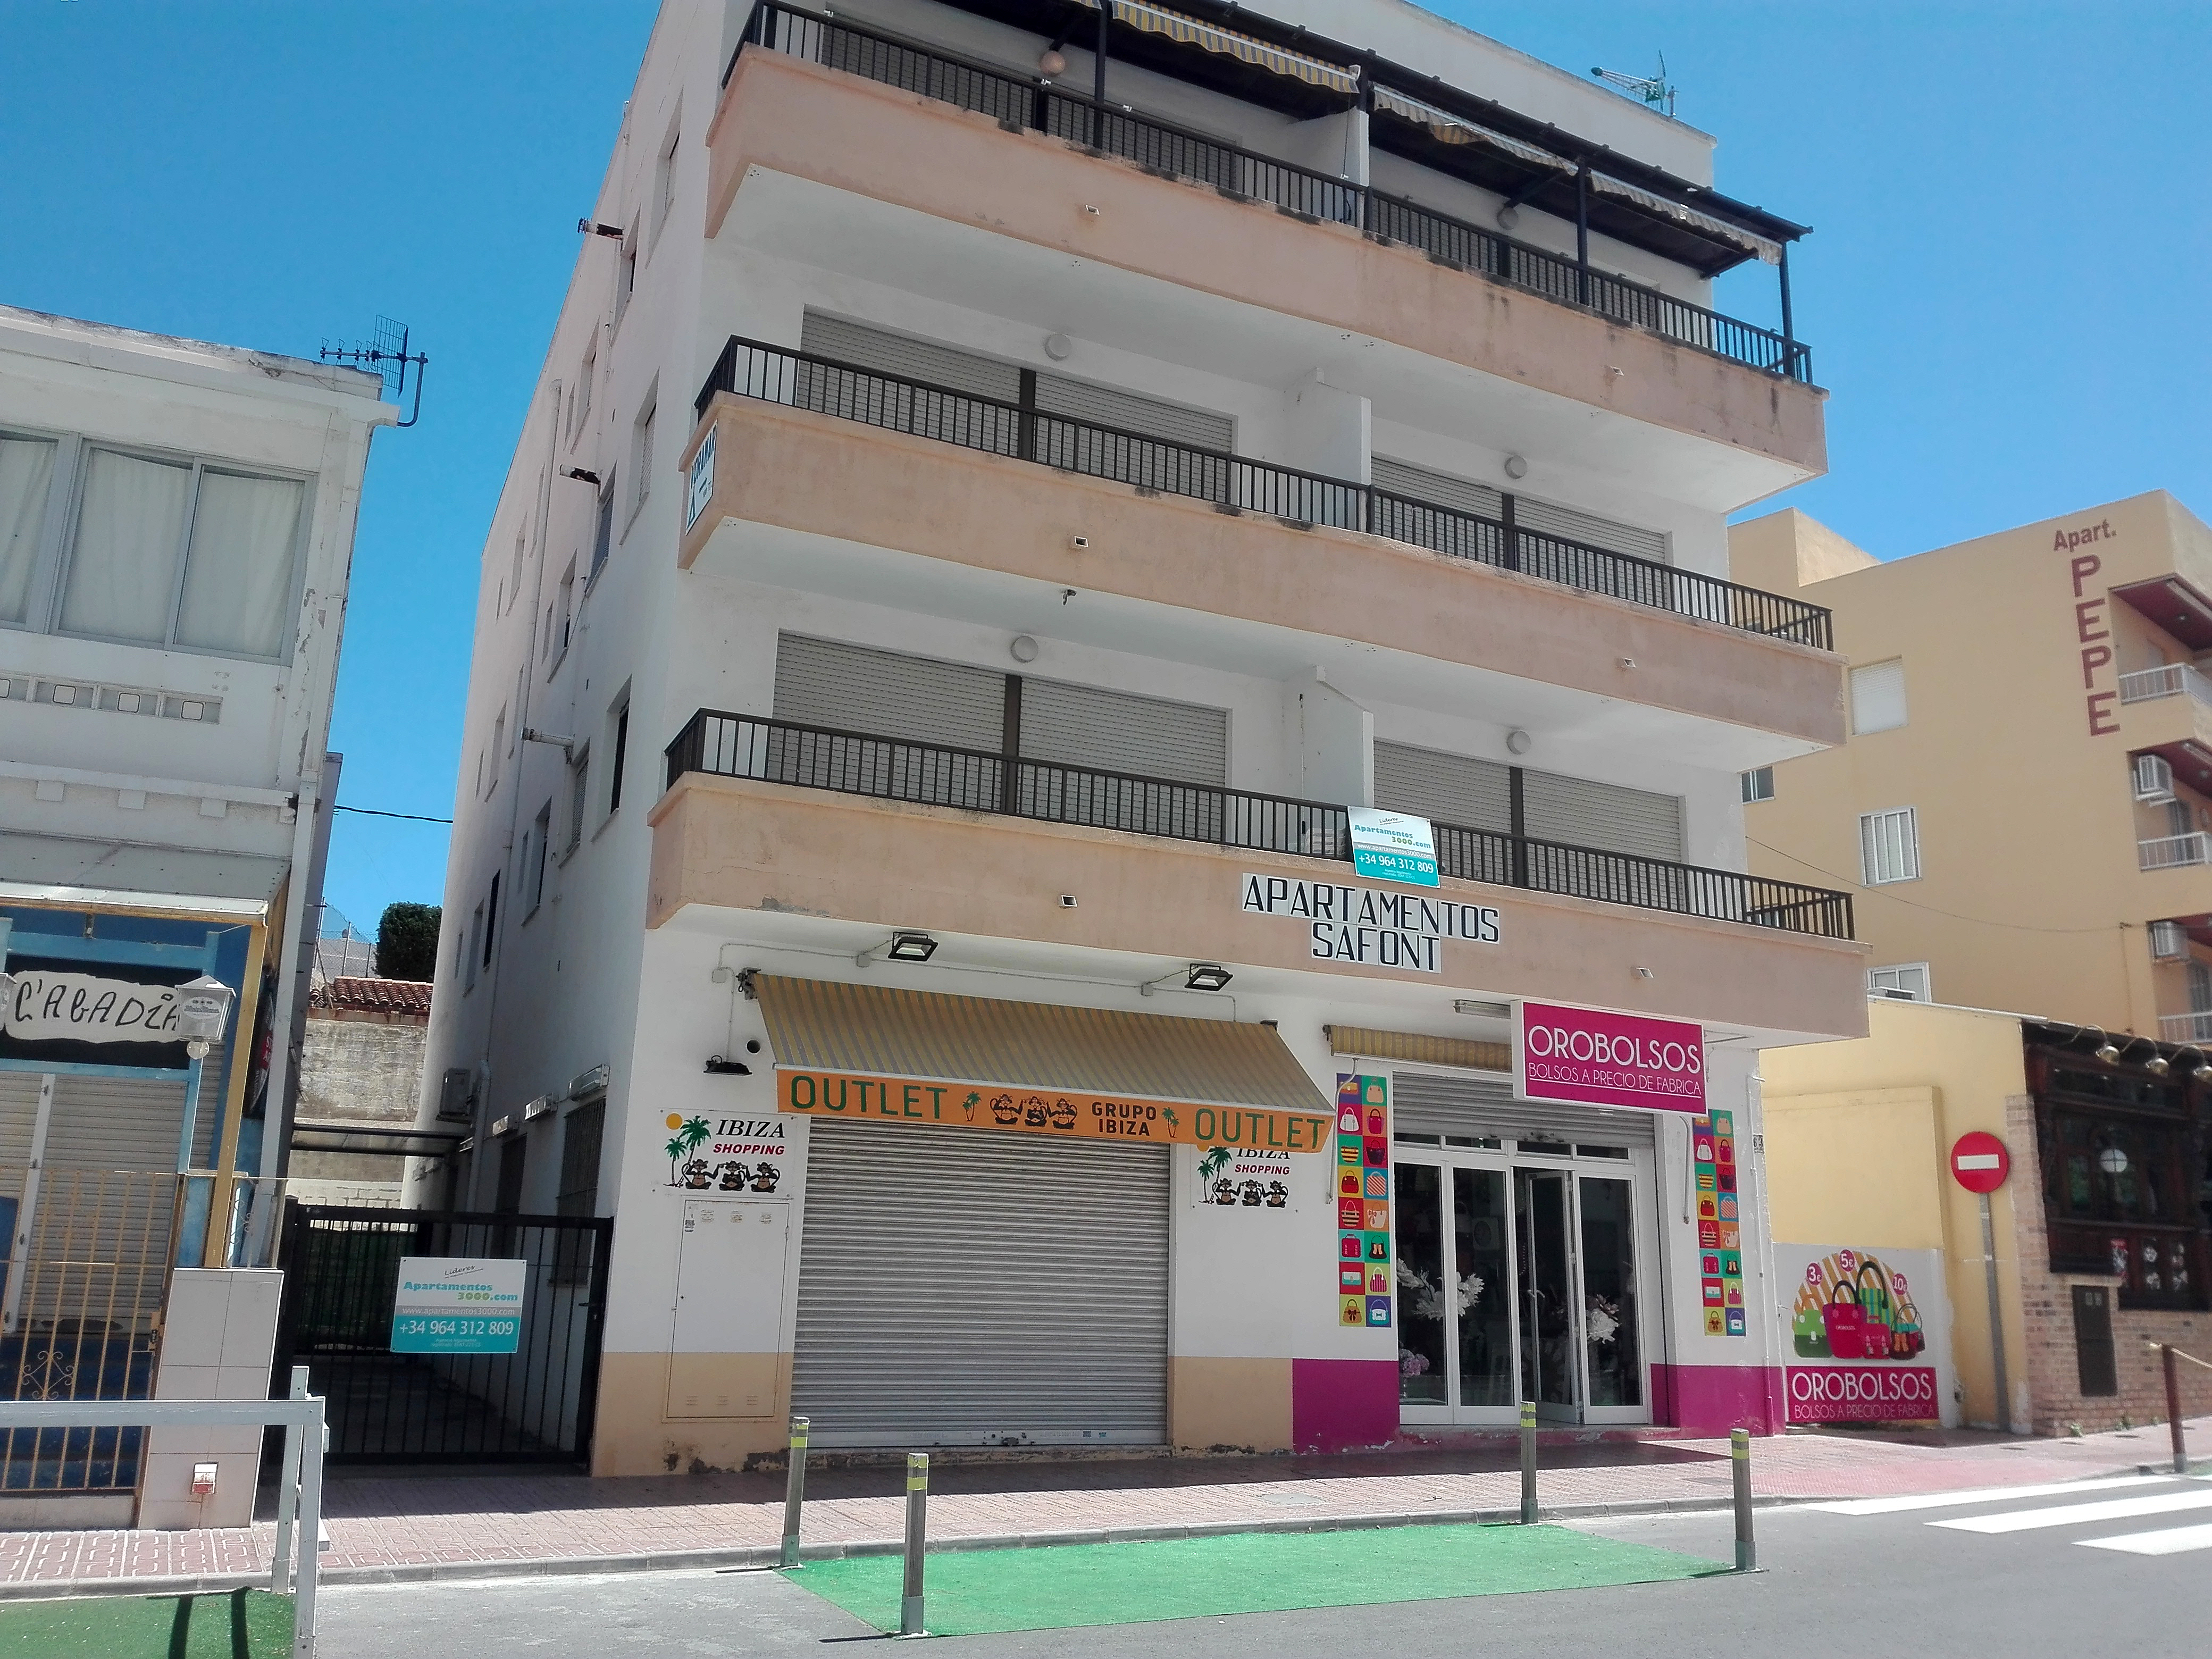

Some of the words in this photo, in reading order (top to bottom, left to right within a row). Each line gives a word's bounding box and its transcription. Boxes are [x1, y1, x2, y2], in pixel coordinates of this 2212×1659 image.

[2053, 519, 2117, 553] Apart.
[2071, 554, 2121, 736] PEPE
[1354, 824, 1413, 839] Apartamentos
[1357, 843, 1432, 859] www.apartamentos3000.com
[1392, 836, 1431, 849] 3000.com
[1359, 853, 1377, 865] +34
[1378, 855, 1396, 867] 964
[1398, 858, 1415, 870] 312
[1417, 861, 1434, 874] 809
[1243, 875, 1498, 942] APARTAMENTOS
[1312, 922, 1439, 970] SAFONT
[1528, 1025, 1701, 1074] OROBOLSOS
[1529, 1062, 1578, 1082] BOLSOS
[1581, 1069, 1590, 1083] A
[1594, 1070, 1636, 1088] PRECIO
[1639, 1075, 1653, 1090] DE
[1657, 1077, 1702, 1095] FABRICA
[791, 1075, 947, 1119] OUTLET
[1092, 1101, 1157, 1120] GRUPO
[716, 1119, 785, 1138] IBIZA
[1099, 1119, 1150, 1137] IBIZA
[1195, 1108, 1325, 1149] OUTLET
[713, 1143, 785, 1155] SHOPPING
[1753, 1137, 1763, 1148] 63
[1235, 1164, 1290, 1175] SHOPPING
[404, 1281, 493, 1292] Apartamentos
[458, 1292, 518, 1301] 3000.com
[403, 1308, 515, 1316] www.apartamentos3000.com
[400, 1320, 425, 1334] +34
[430, 1321, 456, 1334] 964
[459, 1321, 485, 1334] 312
[488, 1321, 514, 1335] 809
[1792, 1372, 1932, 1401] OROBOLSOS
[1795, 1405, 1835, 1419] BOLSOS
[1837, 1405, 1845, 1418] A
[1846, 1404, 1881, 1418] PRECIO
[1883, 1404, 1895, 1418] DE
[1898, 1404, 1934, 1418] FABRICA
